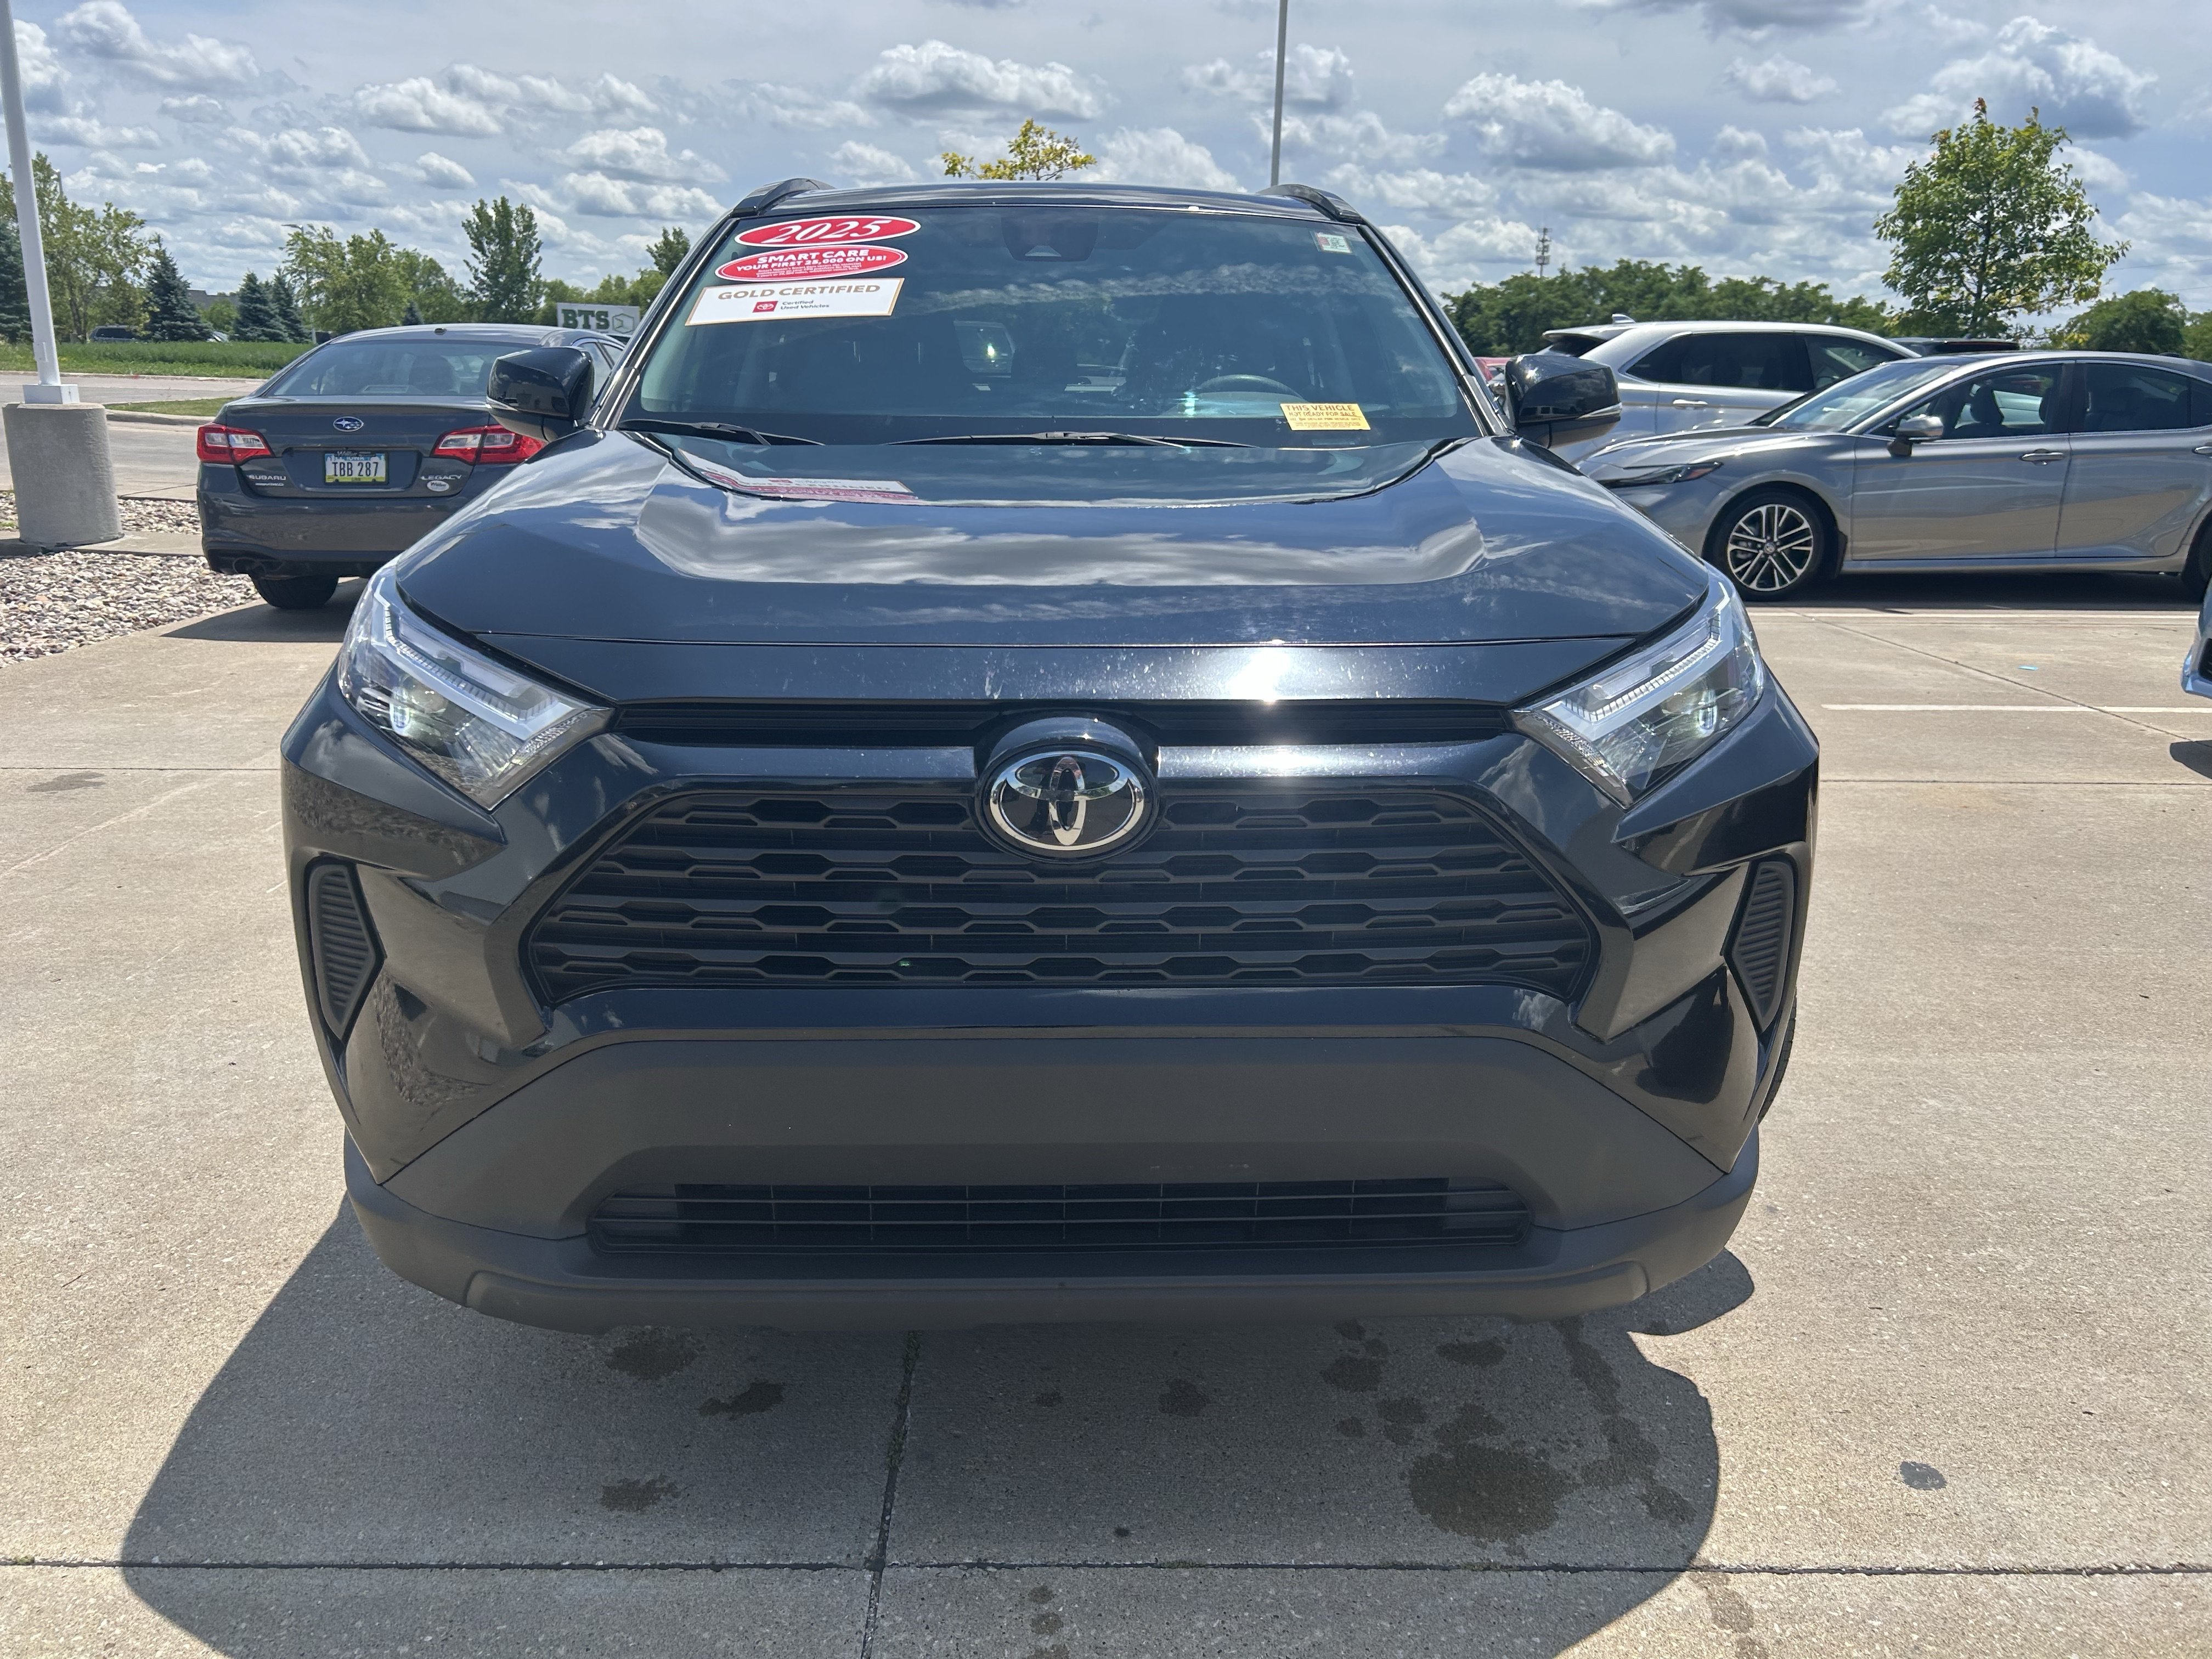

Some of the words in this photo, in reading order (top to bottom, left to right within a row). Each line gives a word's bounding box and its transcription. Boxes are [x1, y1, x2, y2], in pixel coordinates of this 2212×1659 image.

[761, 220, 892, 243] 2025
[757, 252, 820, 263] SMART
[822, 249, 870, 258] CARE
[737, 263, 769, 272] YOUR
[718, 289, 775, 300] GOLD
[778, 285, 881, 296] CERTIFIED
[561, 309, 610, 329] BTS
[358, 462, 379, 477] 287
